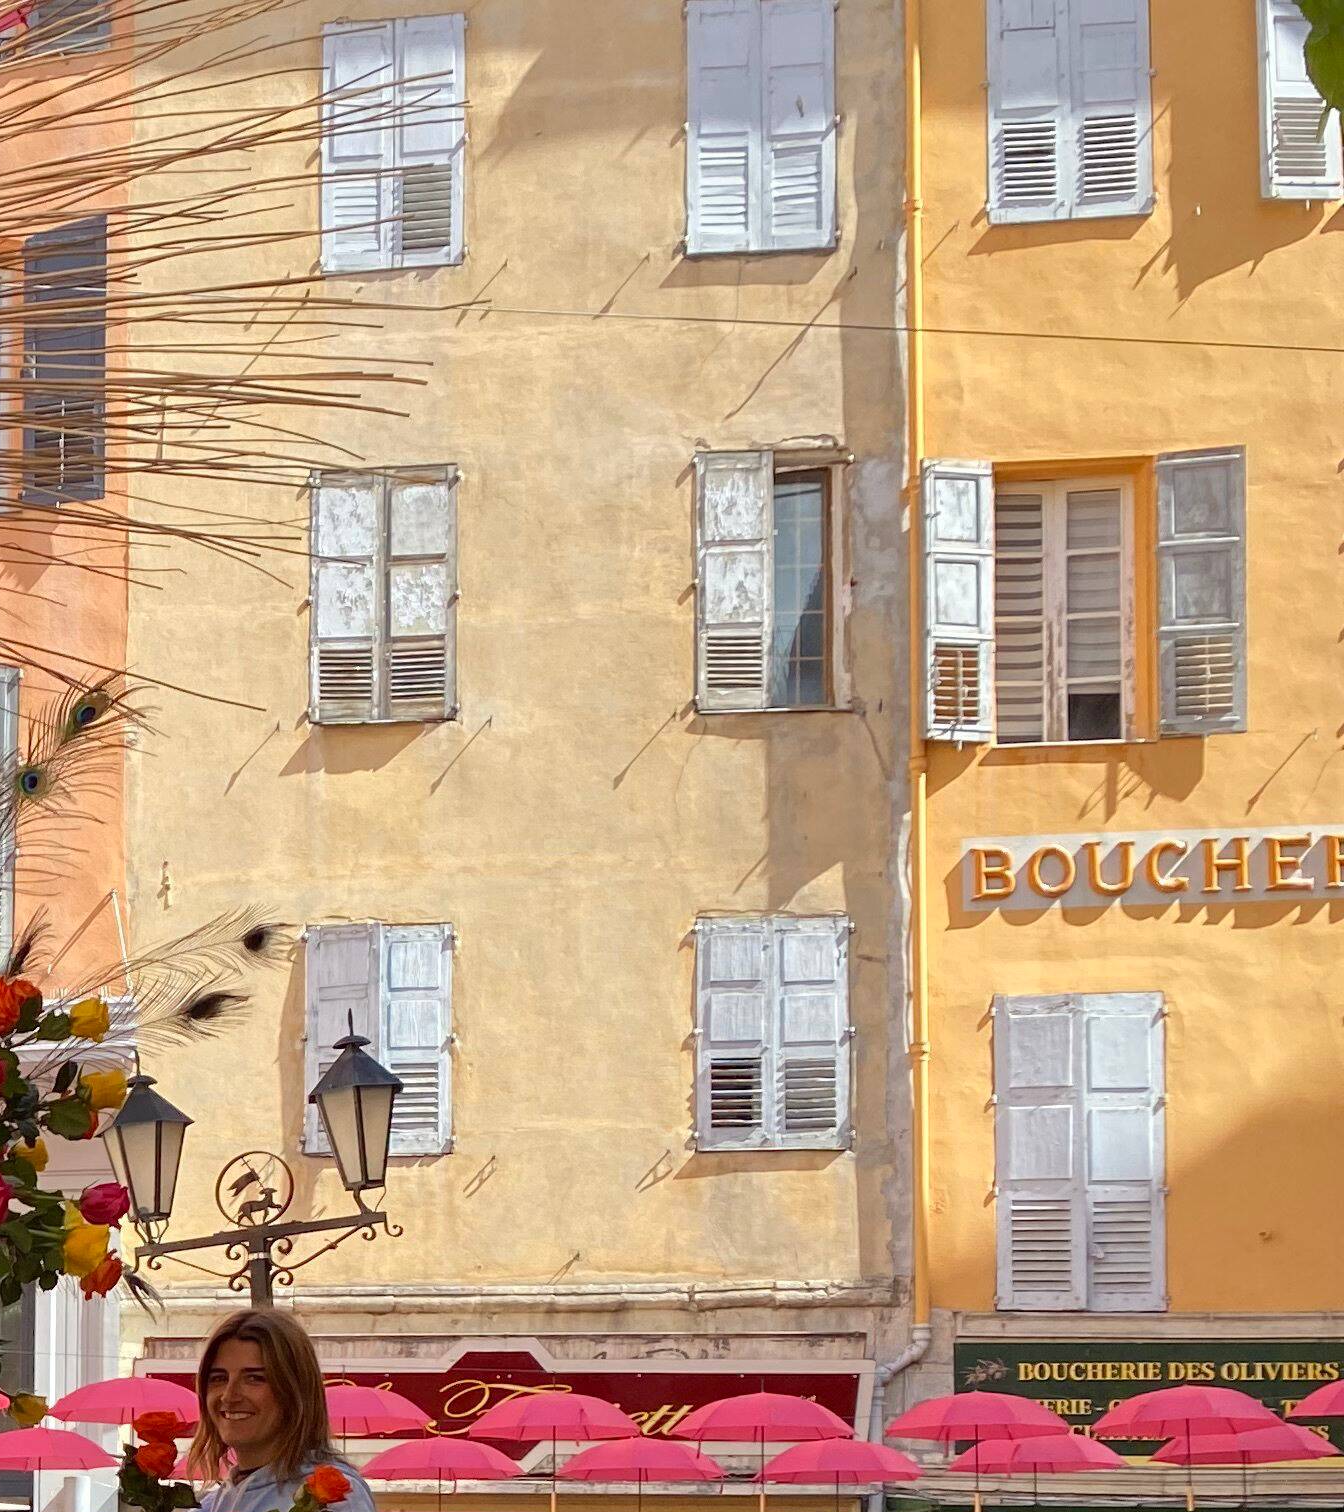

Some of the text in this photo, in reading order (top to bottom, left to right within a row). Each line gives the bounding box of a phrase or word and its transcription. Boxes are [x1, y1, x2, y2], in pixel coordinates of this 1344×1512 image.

[1018, 1361, 1340, 1381] BOUCHERIE DES OLIVIERS
